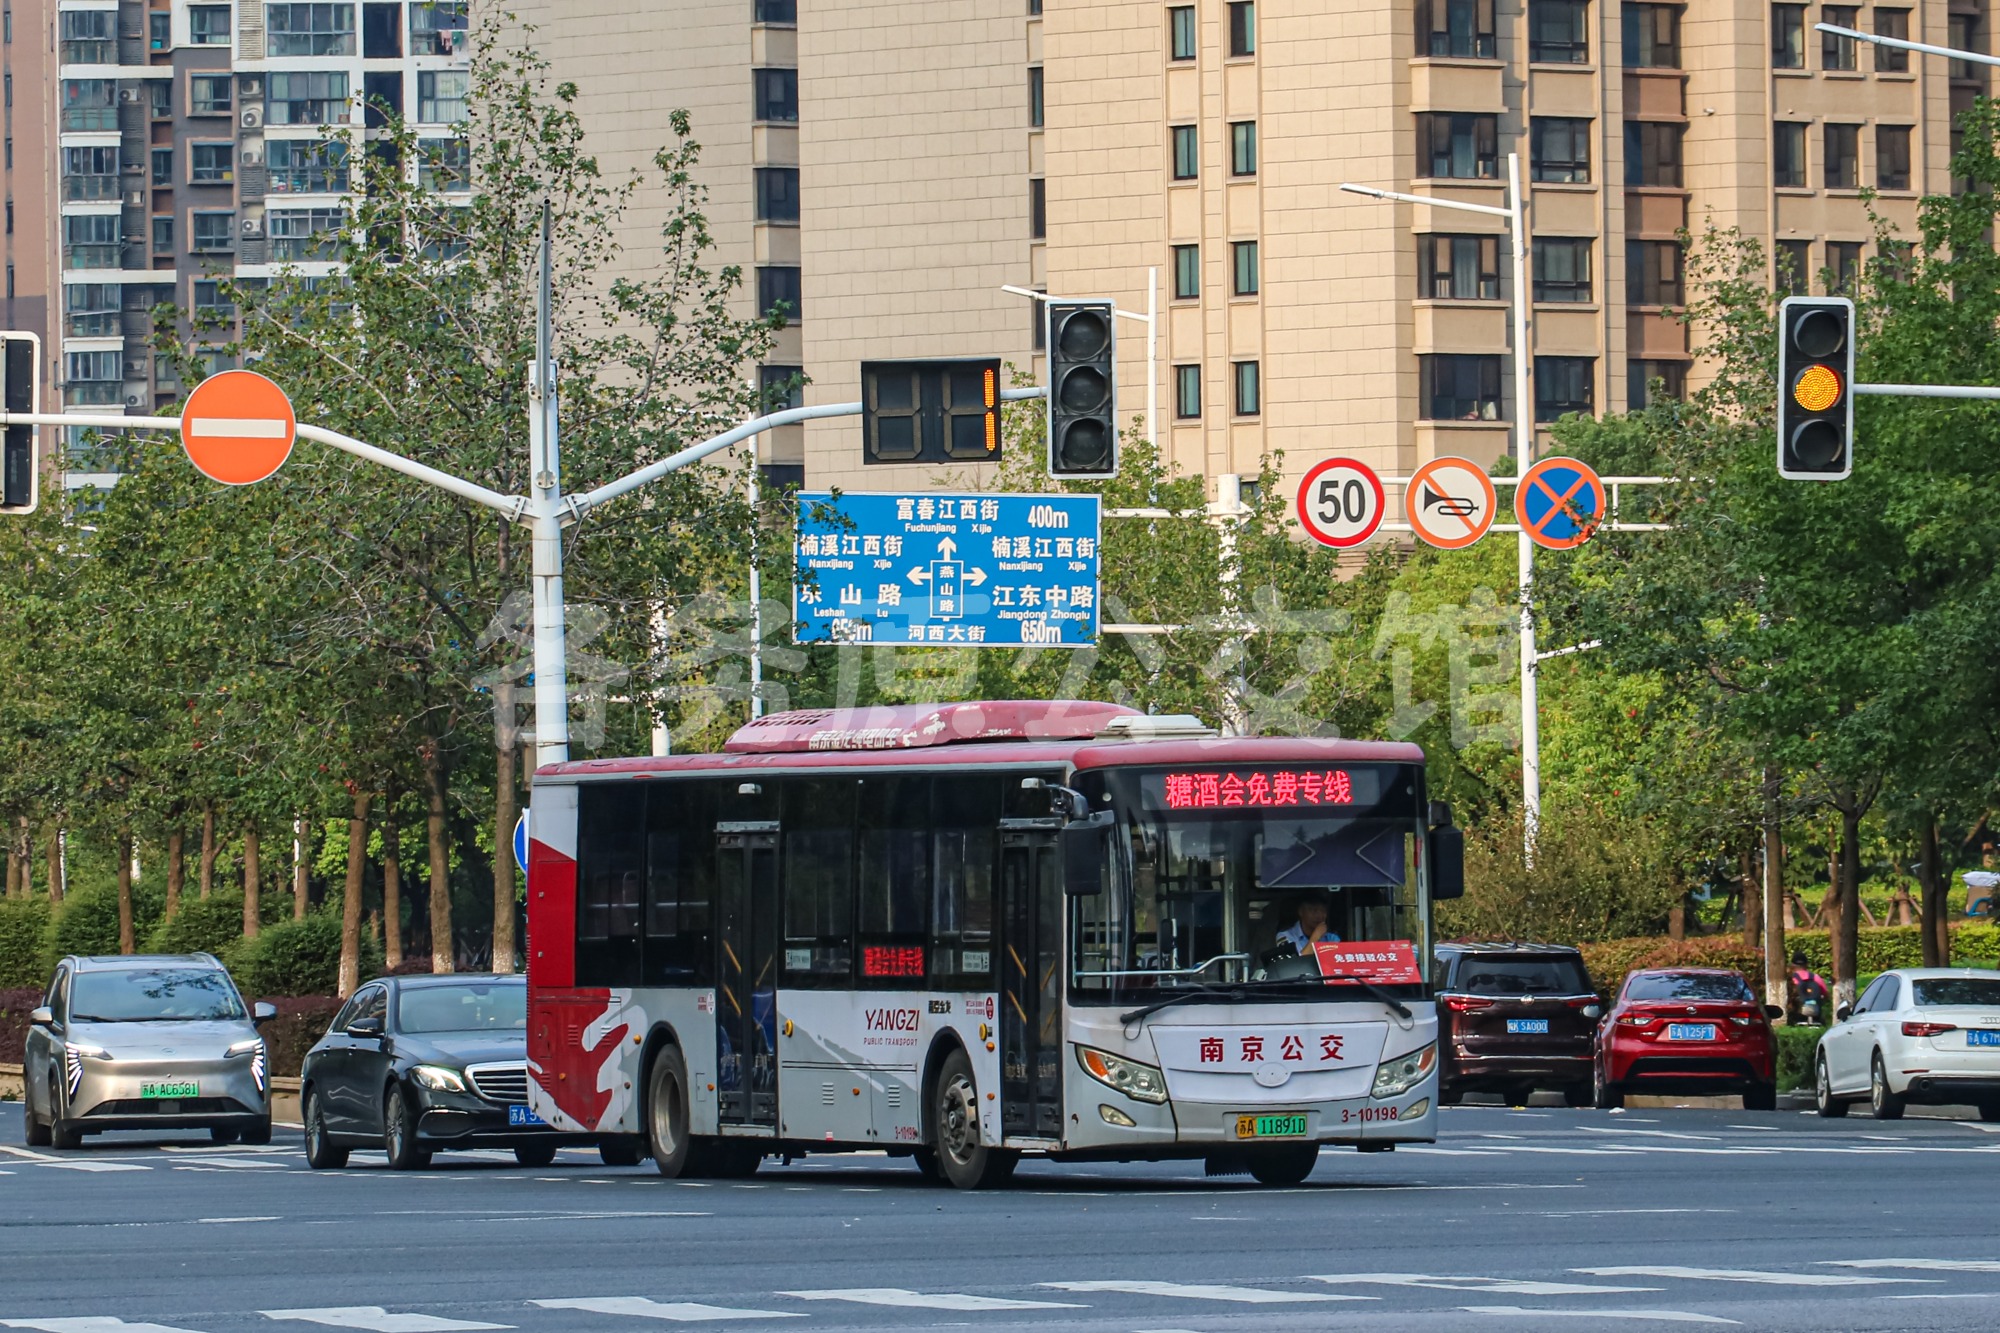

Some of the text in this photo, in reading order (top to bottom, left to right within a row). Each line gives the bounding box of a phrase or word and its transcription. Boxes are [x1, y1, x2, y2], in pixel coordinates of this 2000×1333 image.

[897, 498, 999, 521] 富春江西街
[1317, 479, 1366, 524] 50
[905, 523, 992, 534] Fuchunjiang Xijie
[1027, 505, 1069, 529] 400m
[800, 534, 903, 557] 楠溪江西街
[992, 536, 1095, 559] 楠溪江西街
[808, 559, 892, 571] Nanxijiang Xijie
[999, 561, 1087, 573] Nanxijiang Xijie
[939, 565, 955, 613] 燕山路
[993, 585, 1095, 608] 江东中路
[814, 607, 888, 618] Leshan Lu
[997, 609, 1091, 621] Jiangdong Zhonglu
[908, 624, 986, 642] 河西大街
[1020, 620, 1062, 643] 650m
[1165, 769, 1353, 808] 糖酒会免费专线
[865, 1008, 920, 1031] YANGZI
[863, 1037, 918, 1046] PUBLIC TRANSPORT
[1199, 1034, 1344, 1063] 南京公交
[1341, 1106, 1398, 1123] 3-10198
